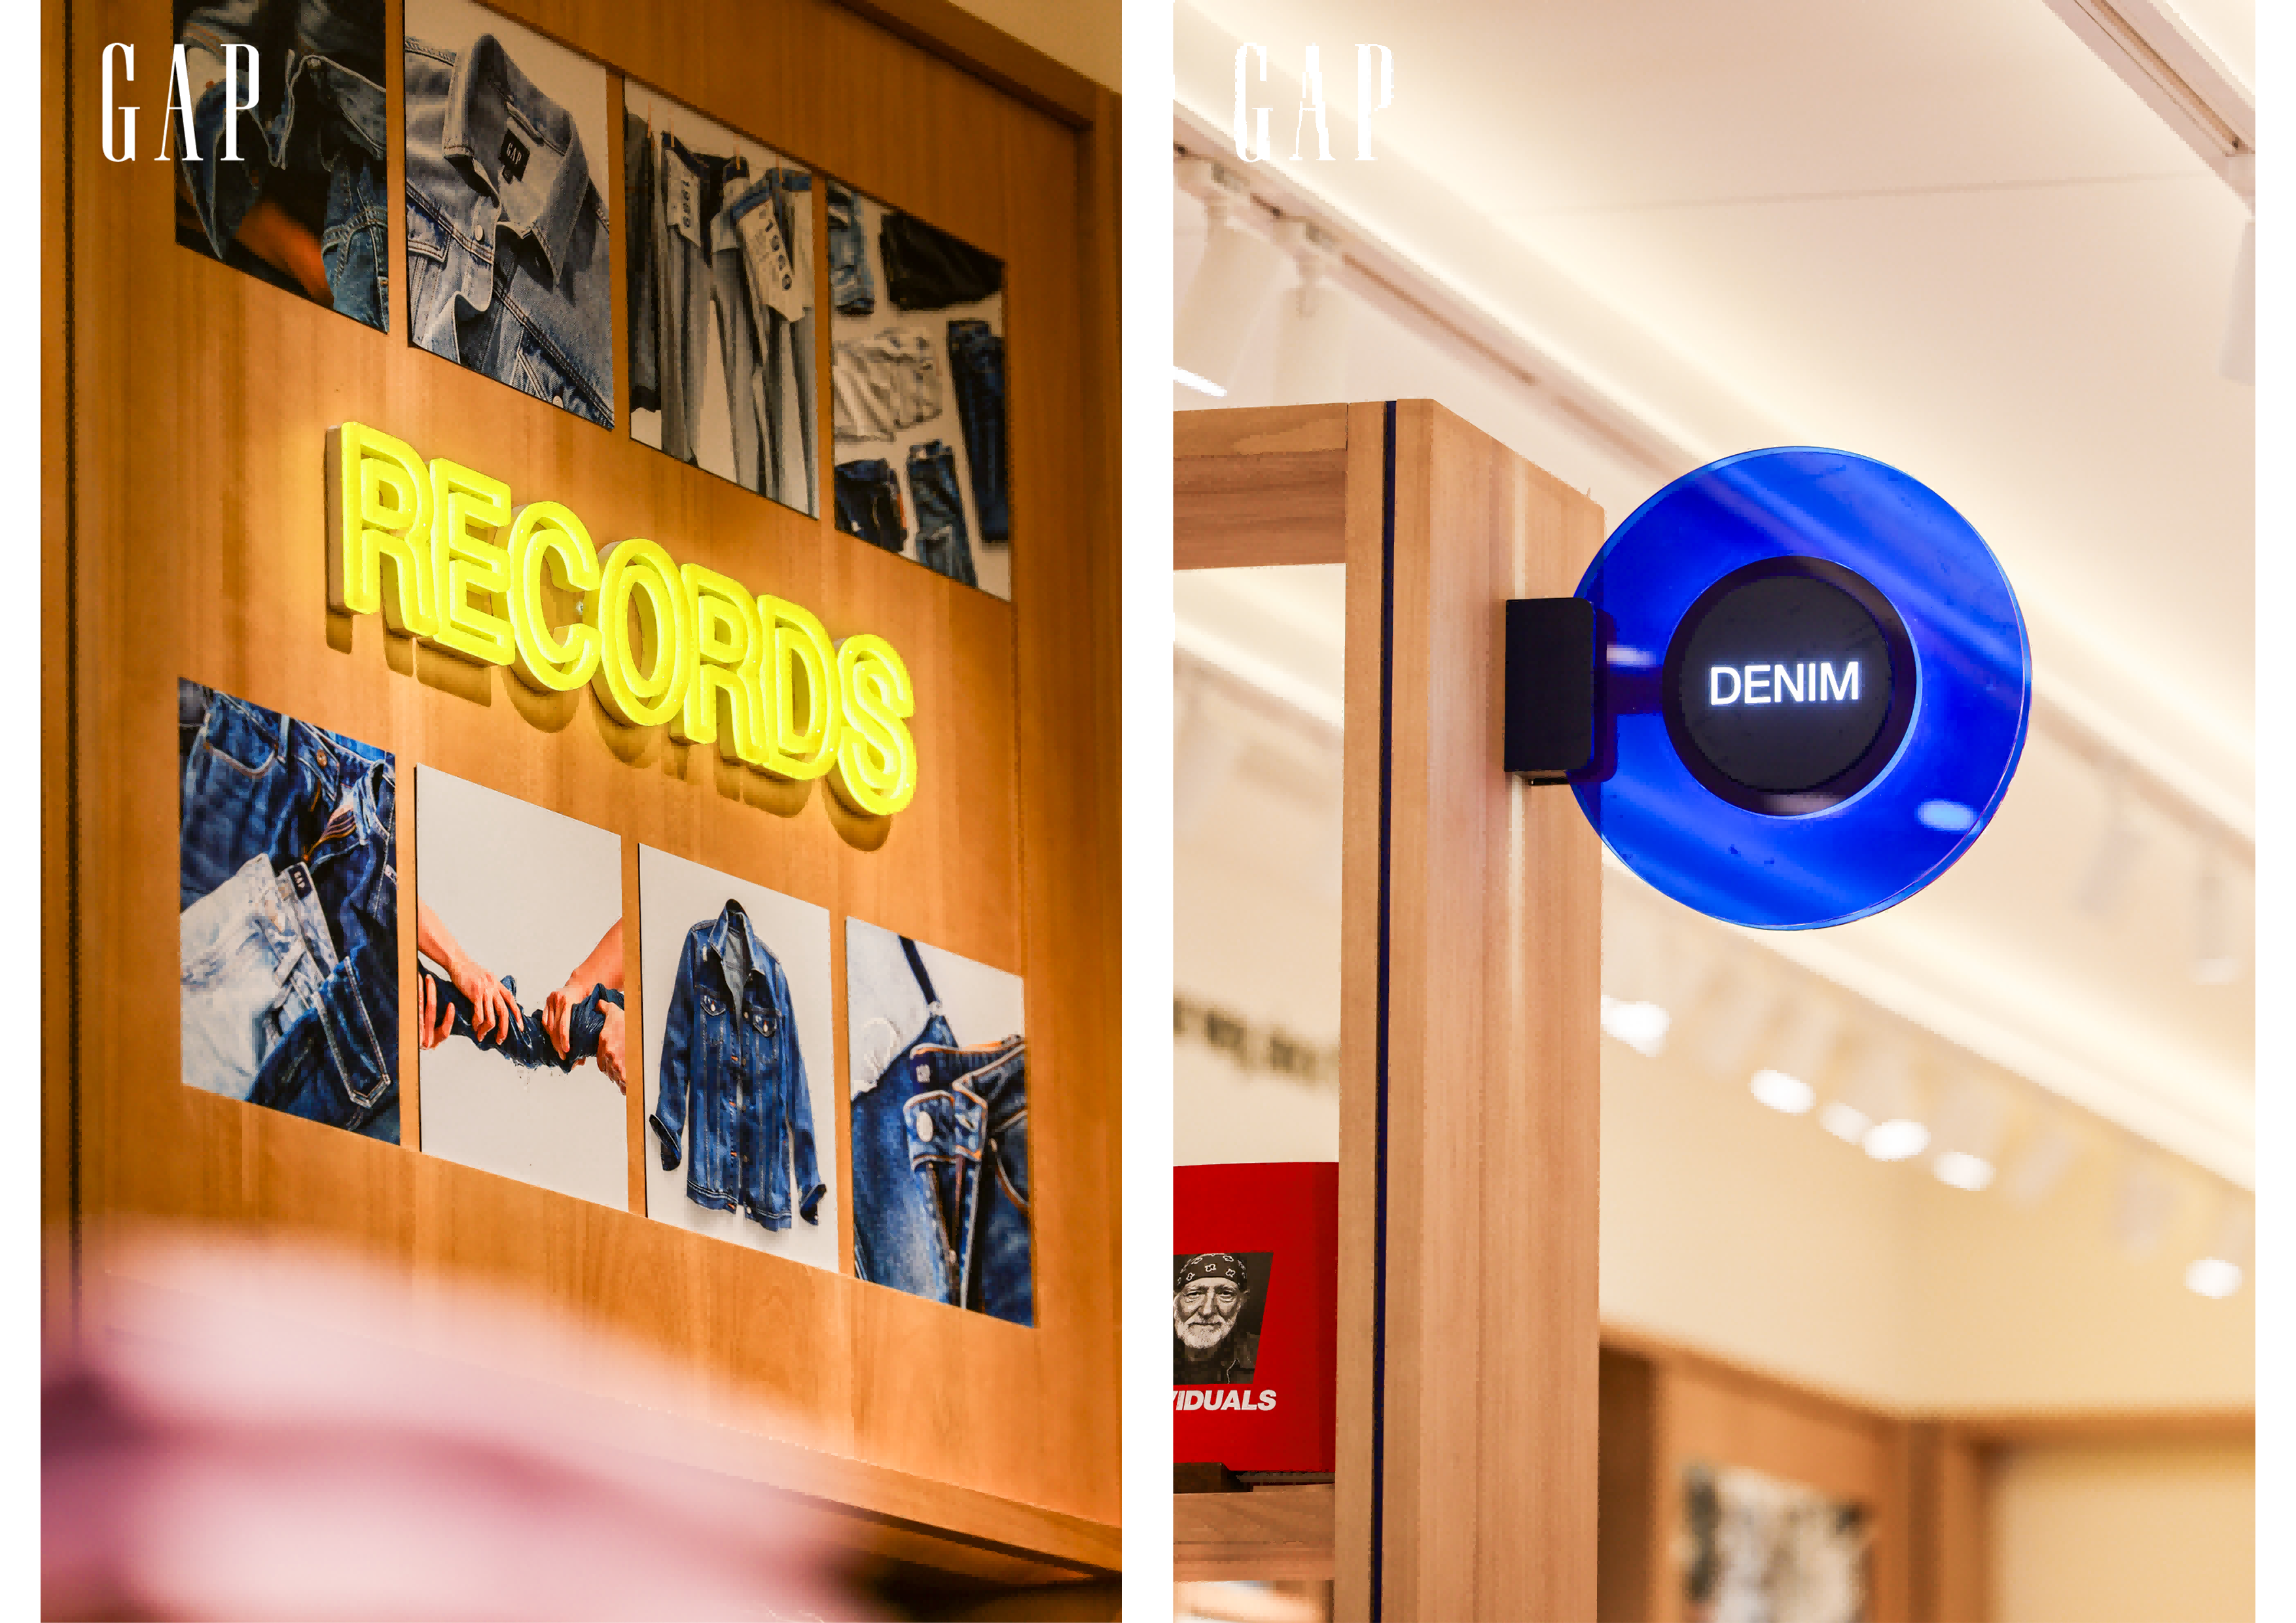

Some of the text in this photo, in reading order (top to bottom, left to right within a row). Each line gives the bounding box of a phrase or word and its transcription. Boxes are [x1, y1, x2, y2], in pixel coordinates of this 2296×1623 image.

[506, 142, 522, 164] GAP
[338, 421, 918, 815] RECORDS
[1710, 661, 1859, 705] DENIM
